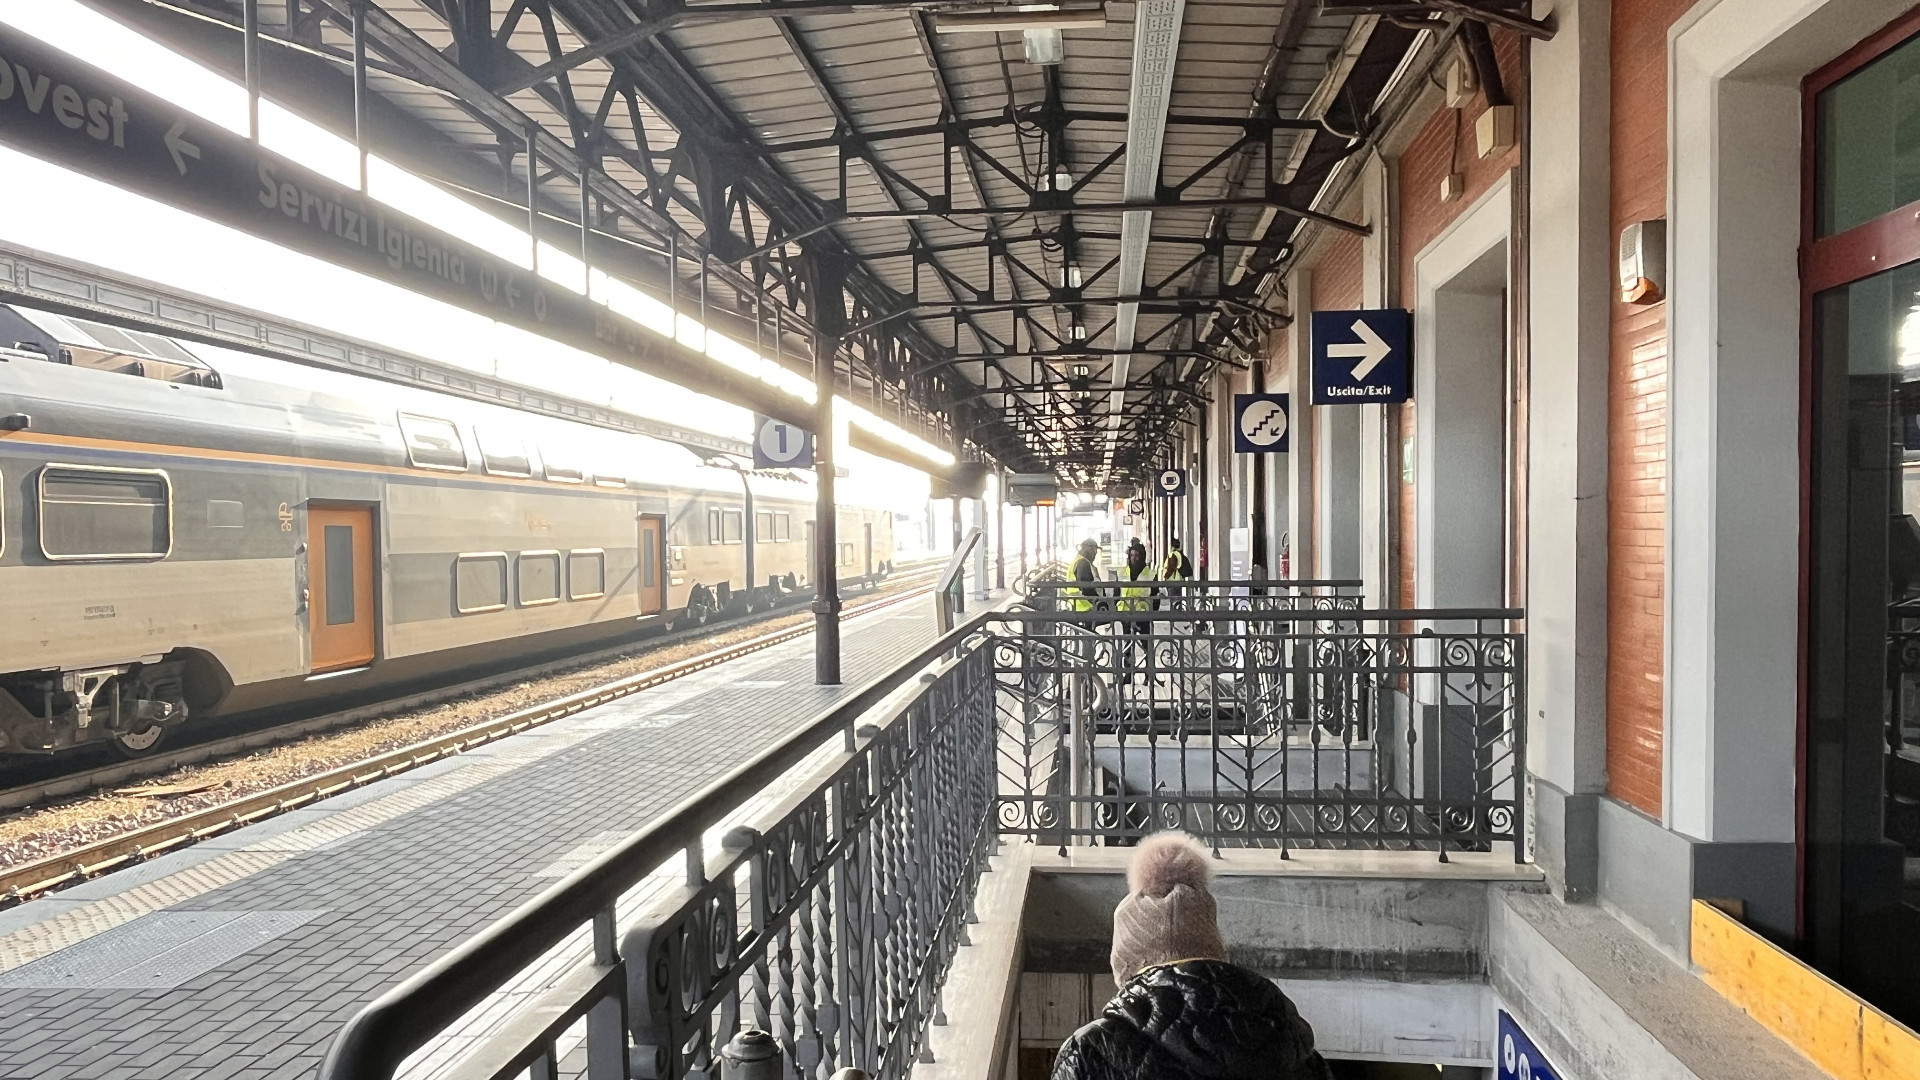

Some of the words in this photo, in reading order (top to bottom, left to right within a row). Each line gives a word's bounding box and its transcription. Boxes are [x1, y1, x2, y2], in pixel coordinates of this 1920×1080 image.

[257, 162, 368, 247] Servizi
[376, 209, 466, 286] Igienici
[1327, 385, 1392, 397] Uscita/Exit
[774, 424, 787, 454] 1
